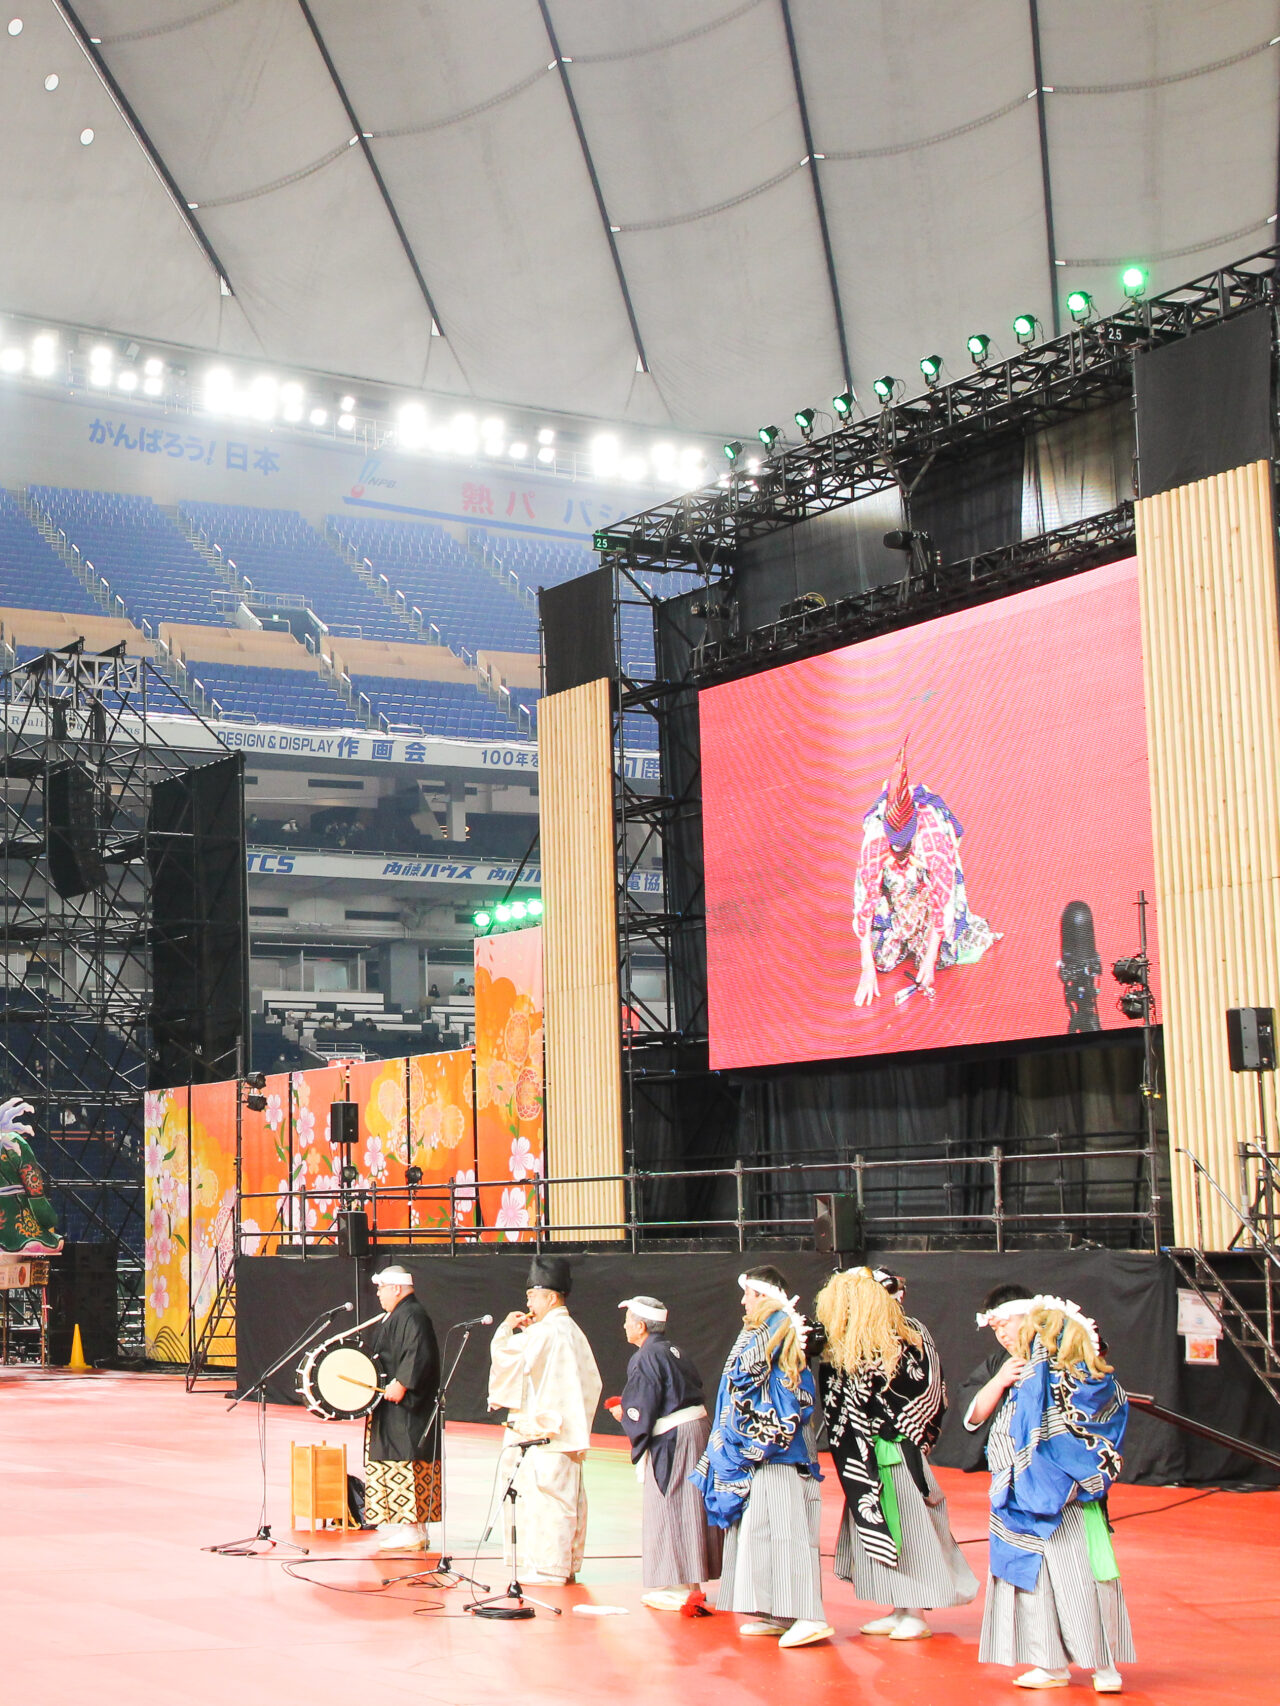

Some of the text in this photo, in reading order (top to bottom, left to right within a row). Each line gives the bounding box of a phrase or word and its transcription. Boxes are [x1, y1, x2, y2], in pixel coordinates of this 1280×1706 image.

[216, 730, 266, 748] DESIGN
[279, 736, 334, 754] DISPLAY
[337, 736, 427, 763] 作画会
